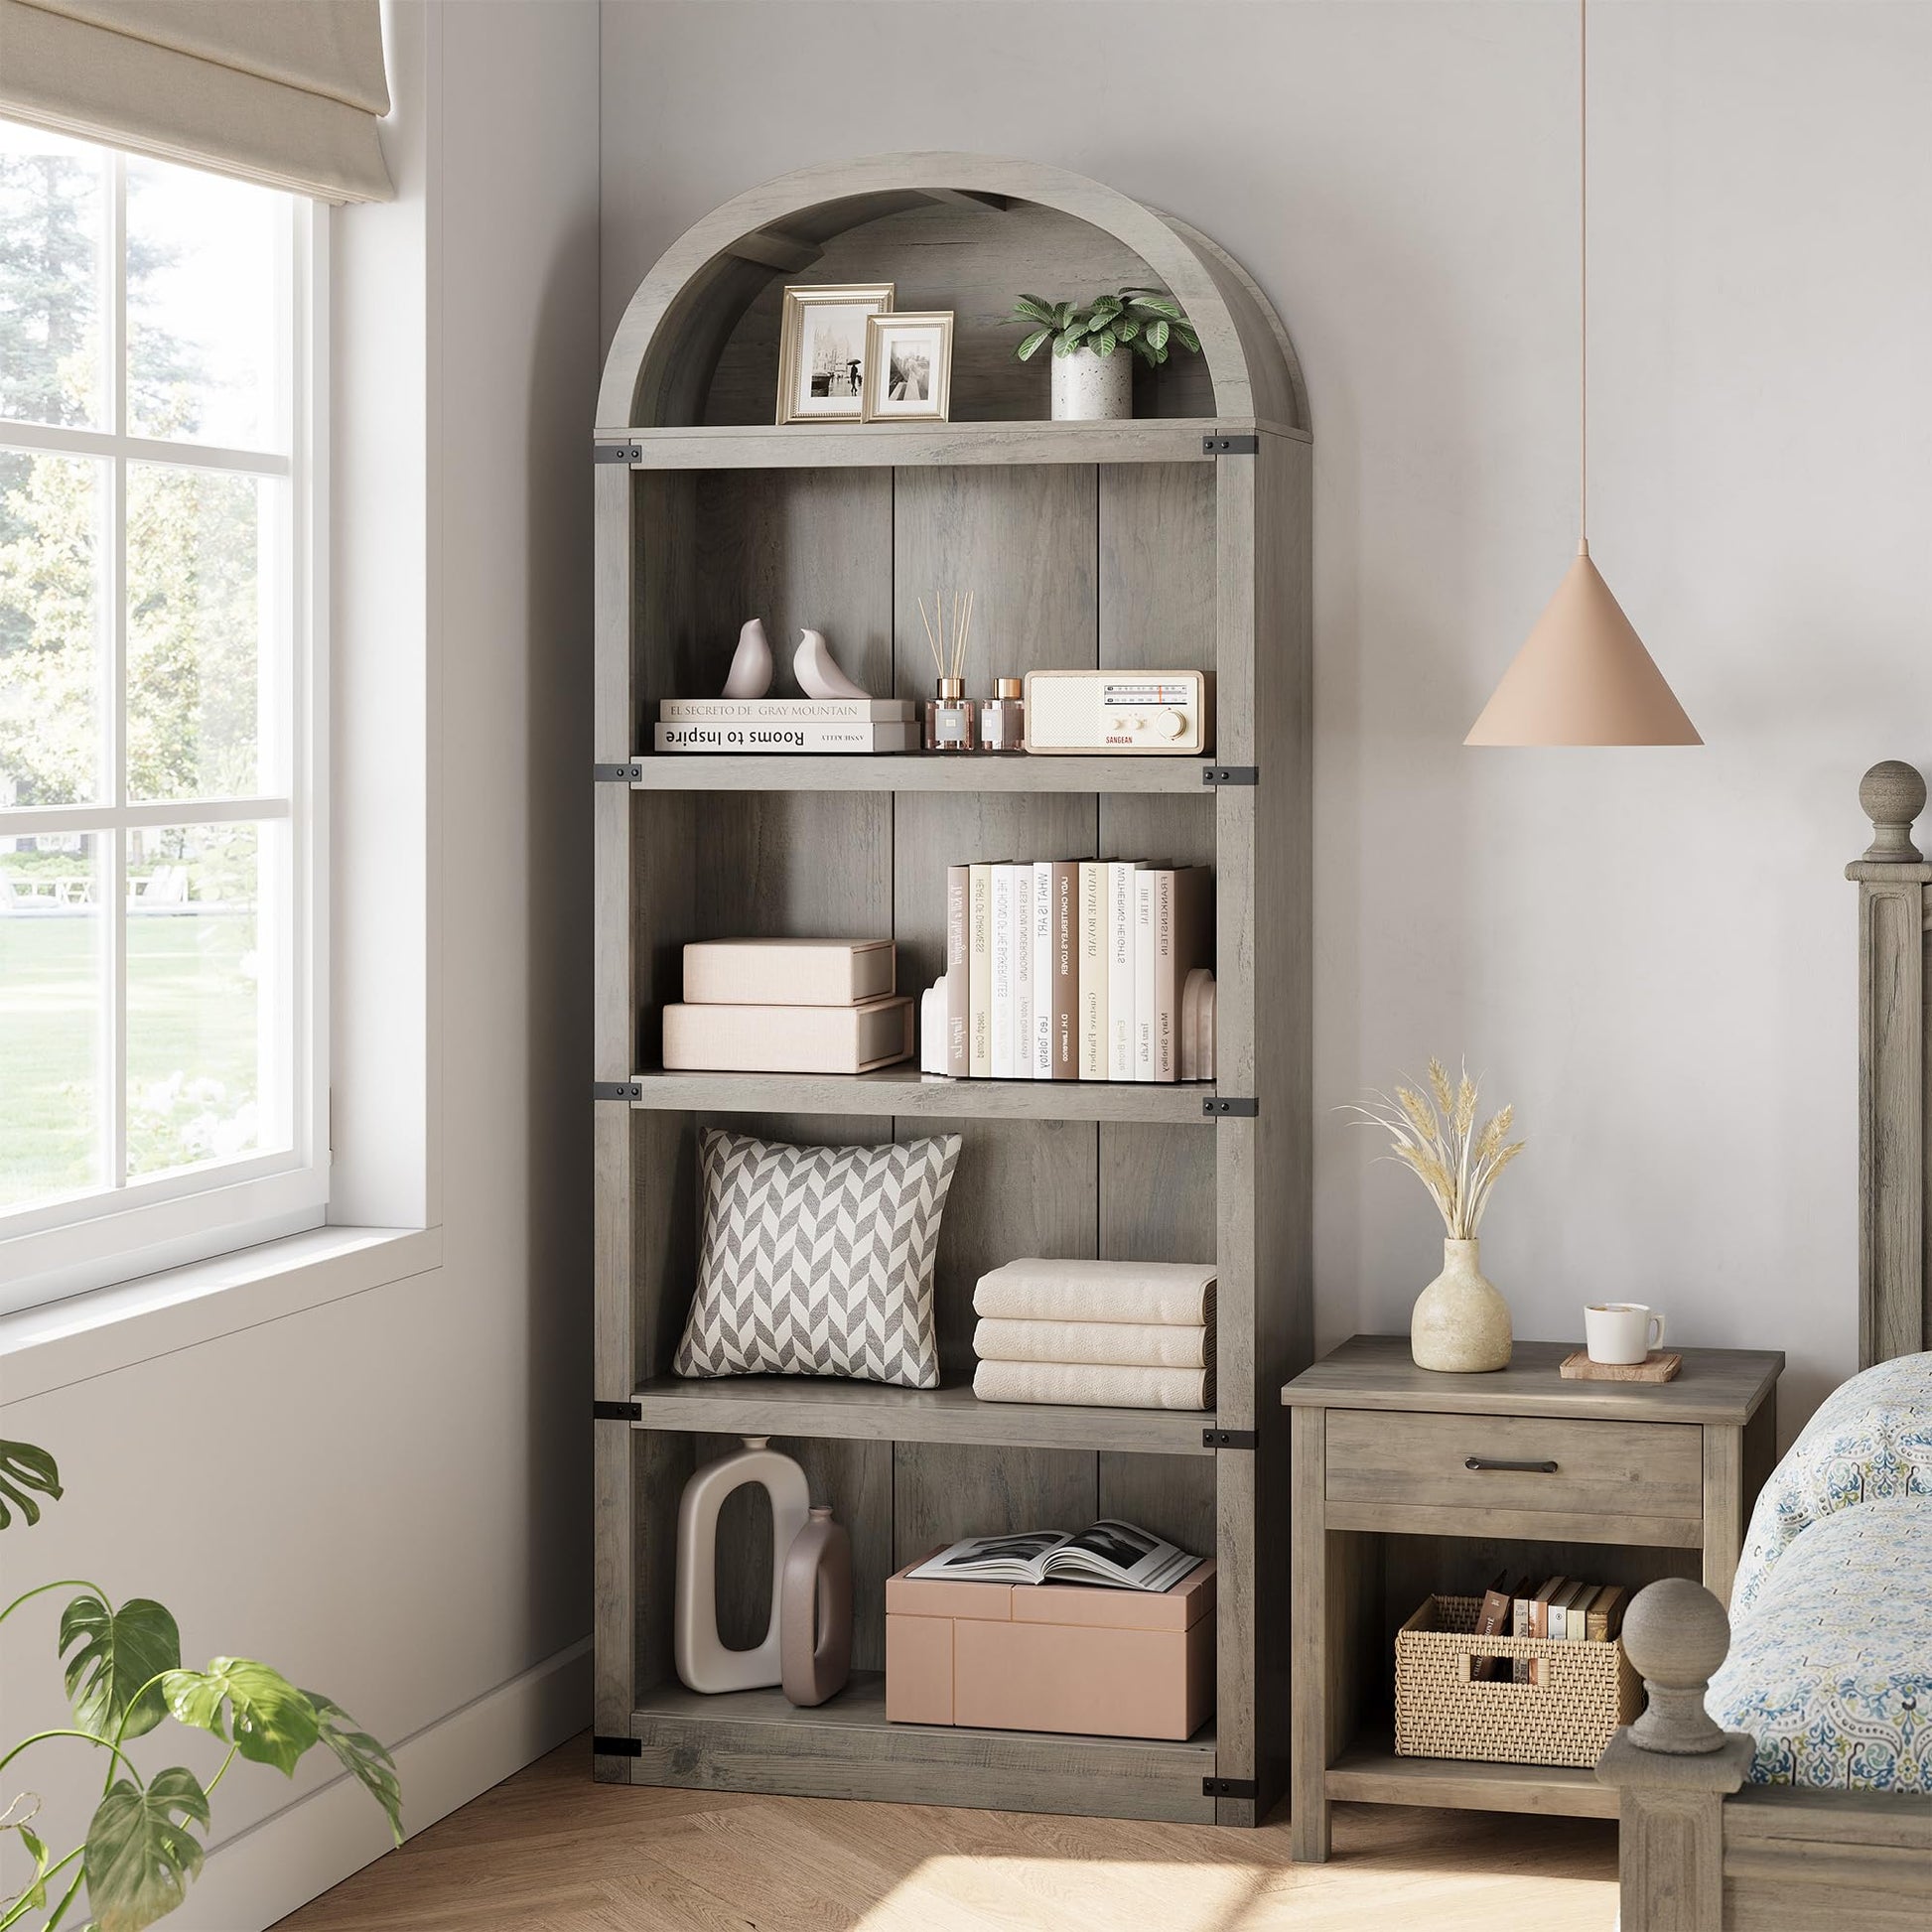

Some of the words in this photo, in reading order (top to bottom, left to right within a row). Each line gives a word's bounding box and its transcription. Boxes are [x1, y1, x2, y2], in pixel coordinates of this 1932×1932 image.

[670, 706, 682, 715] EL
[685, 706, 736, 715] SECRETO
[759, 706, 789, 715] GRAY
[792, 706, 858, 715] MOUNTAIN
[666, 727, 721, 746] Inspire
[728, 732, 744, 745] to
[749, 732, 803, 746] Rooms
